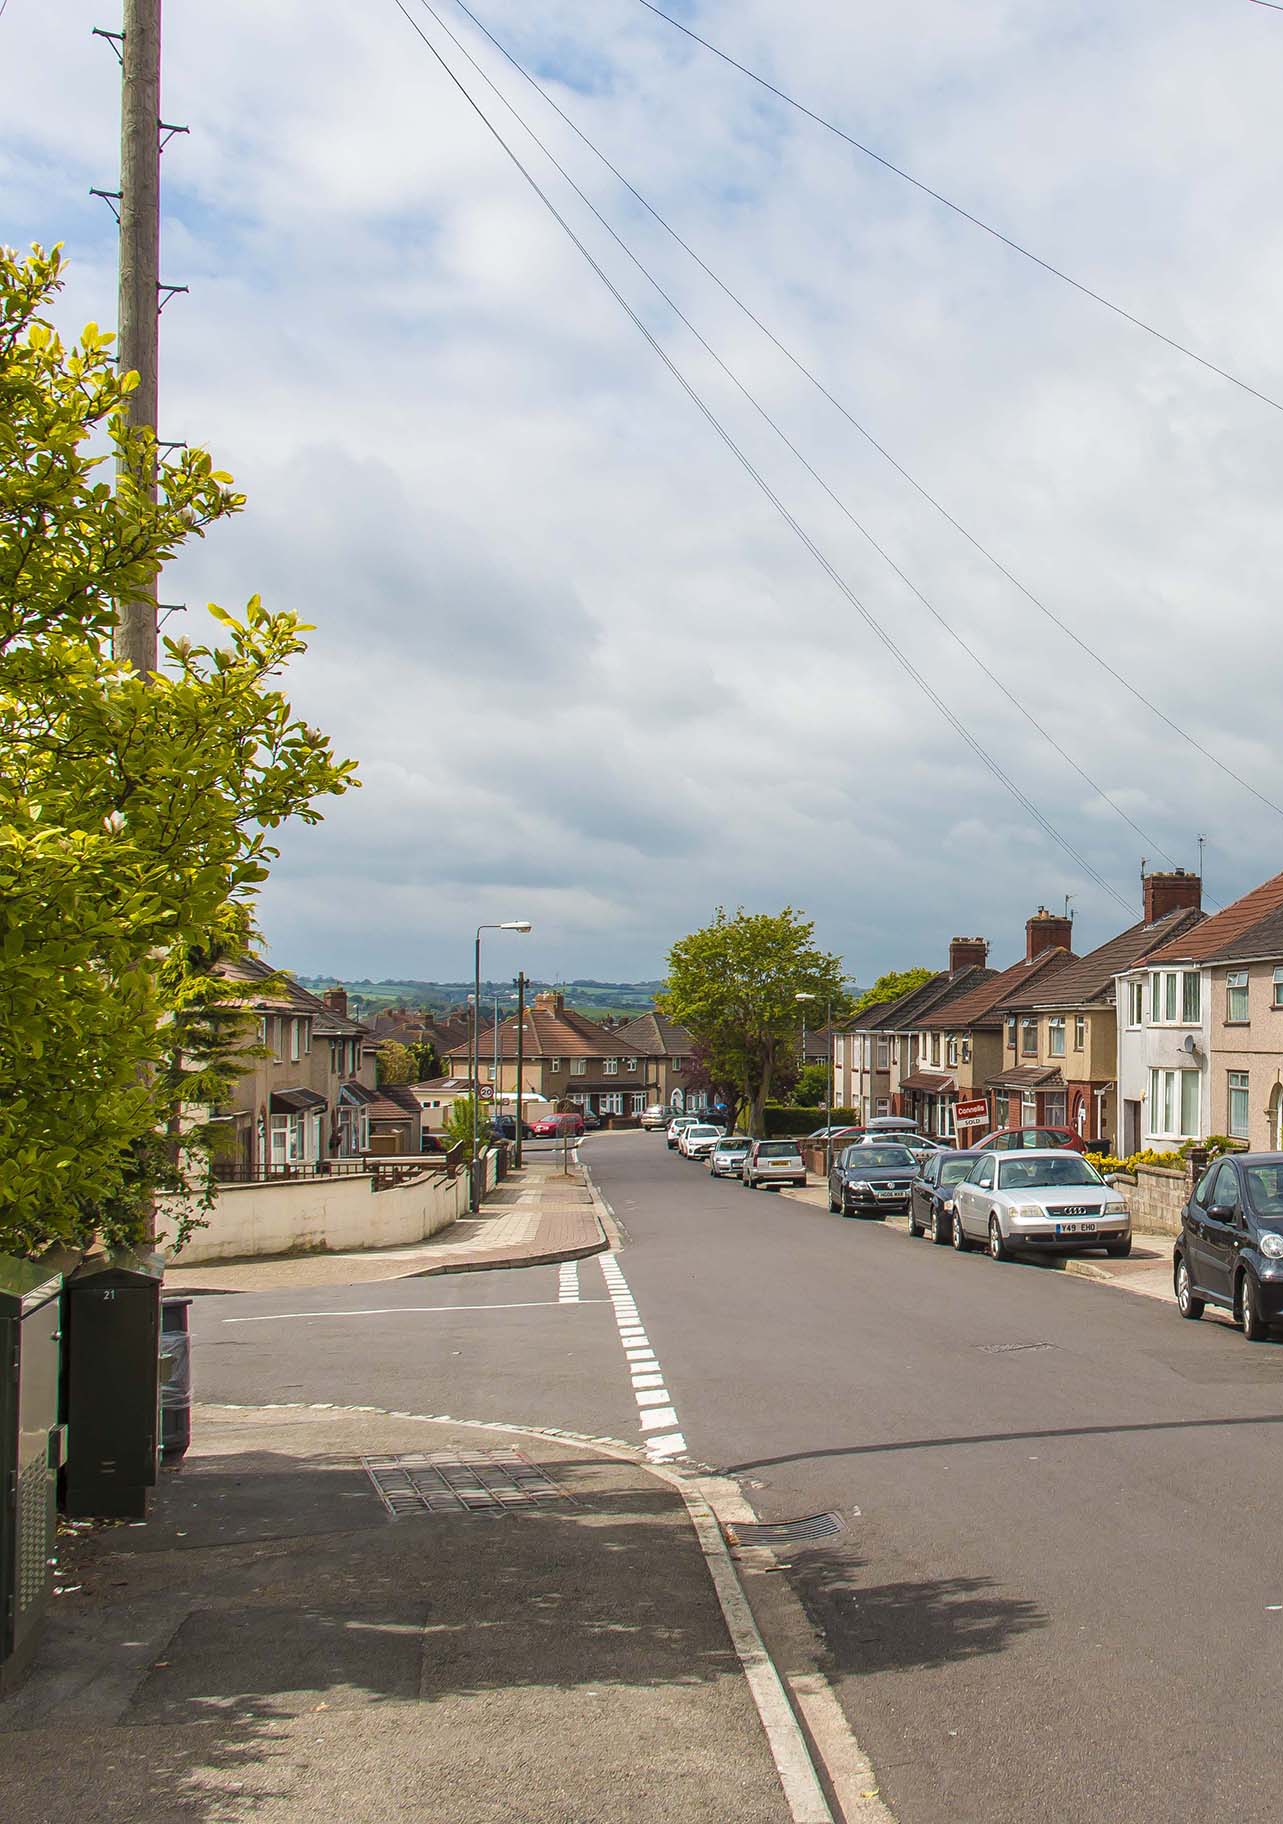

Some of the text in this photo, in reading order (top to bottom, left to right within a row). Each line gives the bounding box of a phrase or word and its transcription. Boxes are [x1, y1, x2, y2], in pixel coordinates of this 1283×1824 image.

[964, 1118, 981, 1126] SOLD
[1062, 1224, 1076, 1232] Y49
[103, 1289, 115, 1300] 21
